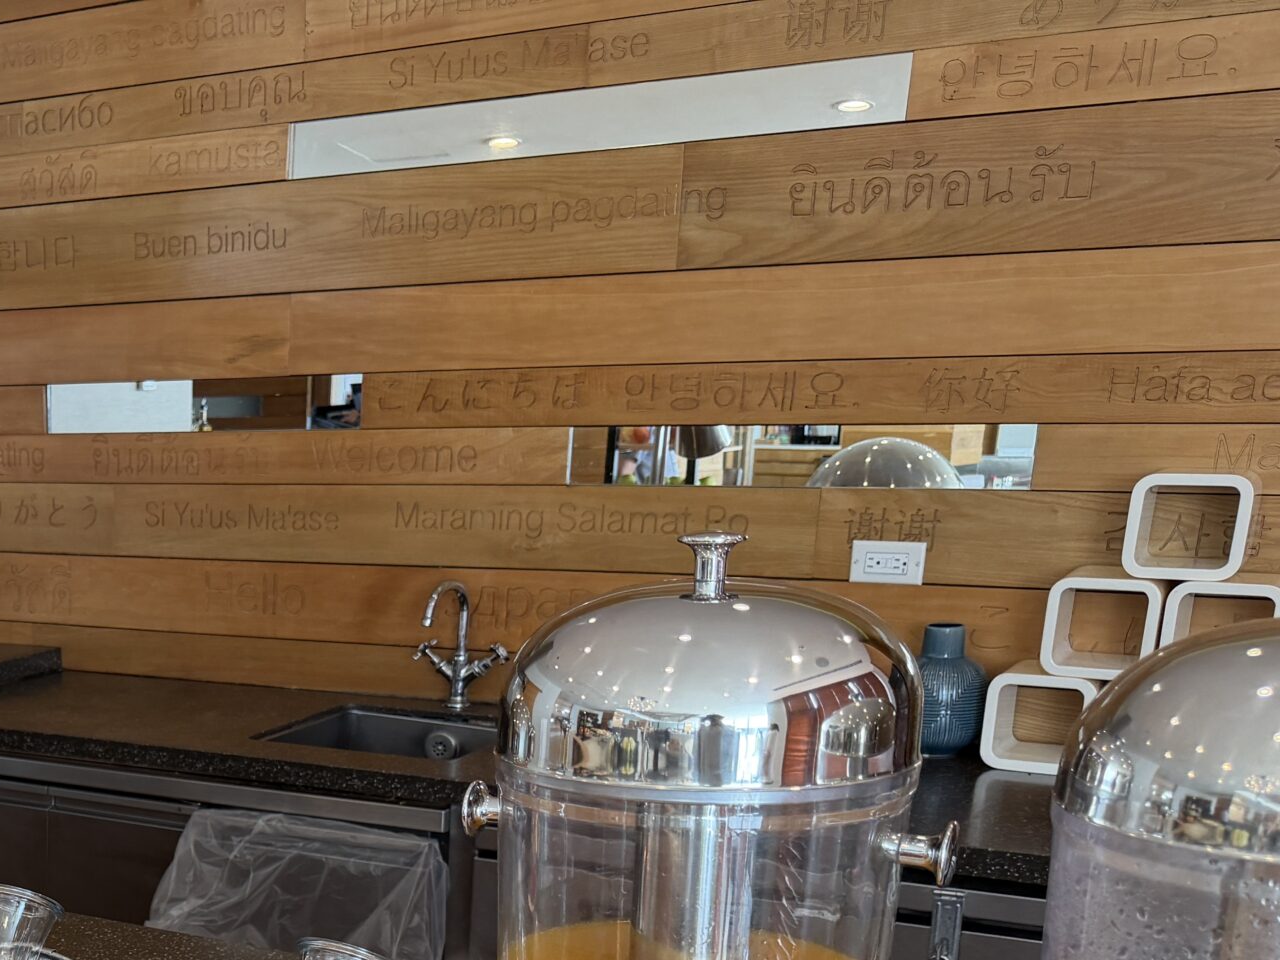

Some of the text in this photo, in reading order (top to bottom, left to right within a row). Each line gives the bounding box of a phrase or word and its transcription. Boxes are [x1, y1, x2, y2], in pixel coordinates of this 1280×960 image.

[388, 55, 416, 90] Si
[426, 49, 508, 85] Yu'us
[939, 32, 1239, 102] 안녕하세요.
[174, 70, 307, 122] ขอบคุณ
[148, 139, 281, 177] kamusta
[788, 143, 1096, 217] ยินดีต้อนรับ
[361, 184, 728, 241] Maligayang pagdating
[132, 222, 287, 261] Buen binidu
[376, 372, 586, 413] こんにちは
[623, 369, 861, 413] 안녕하세요.
[923, 367, 1020, 415] 你好
[312, 438, 478, 474] Welcome
[144, 501, 340, 533] Si Yu'us Ma'ase
[395, 501, 750, 539] Maraming Salamat Po
[204, 569, 307, 616] Hello
